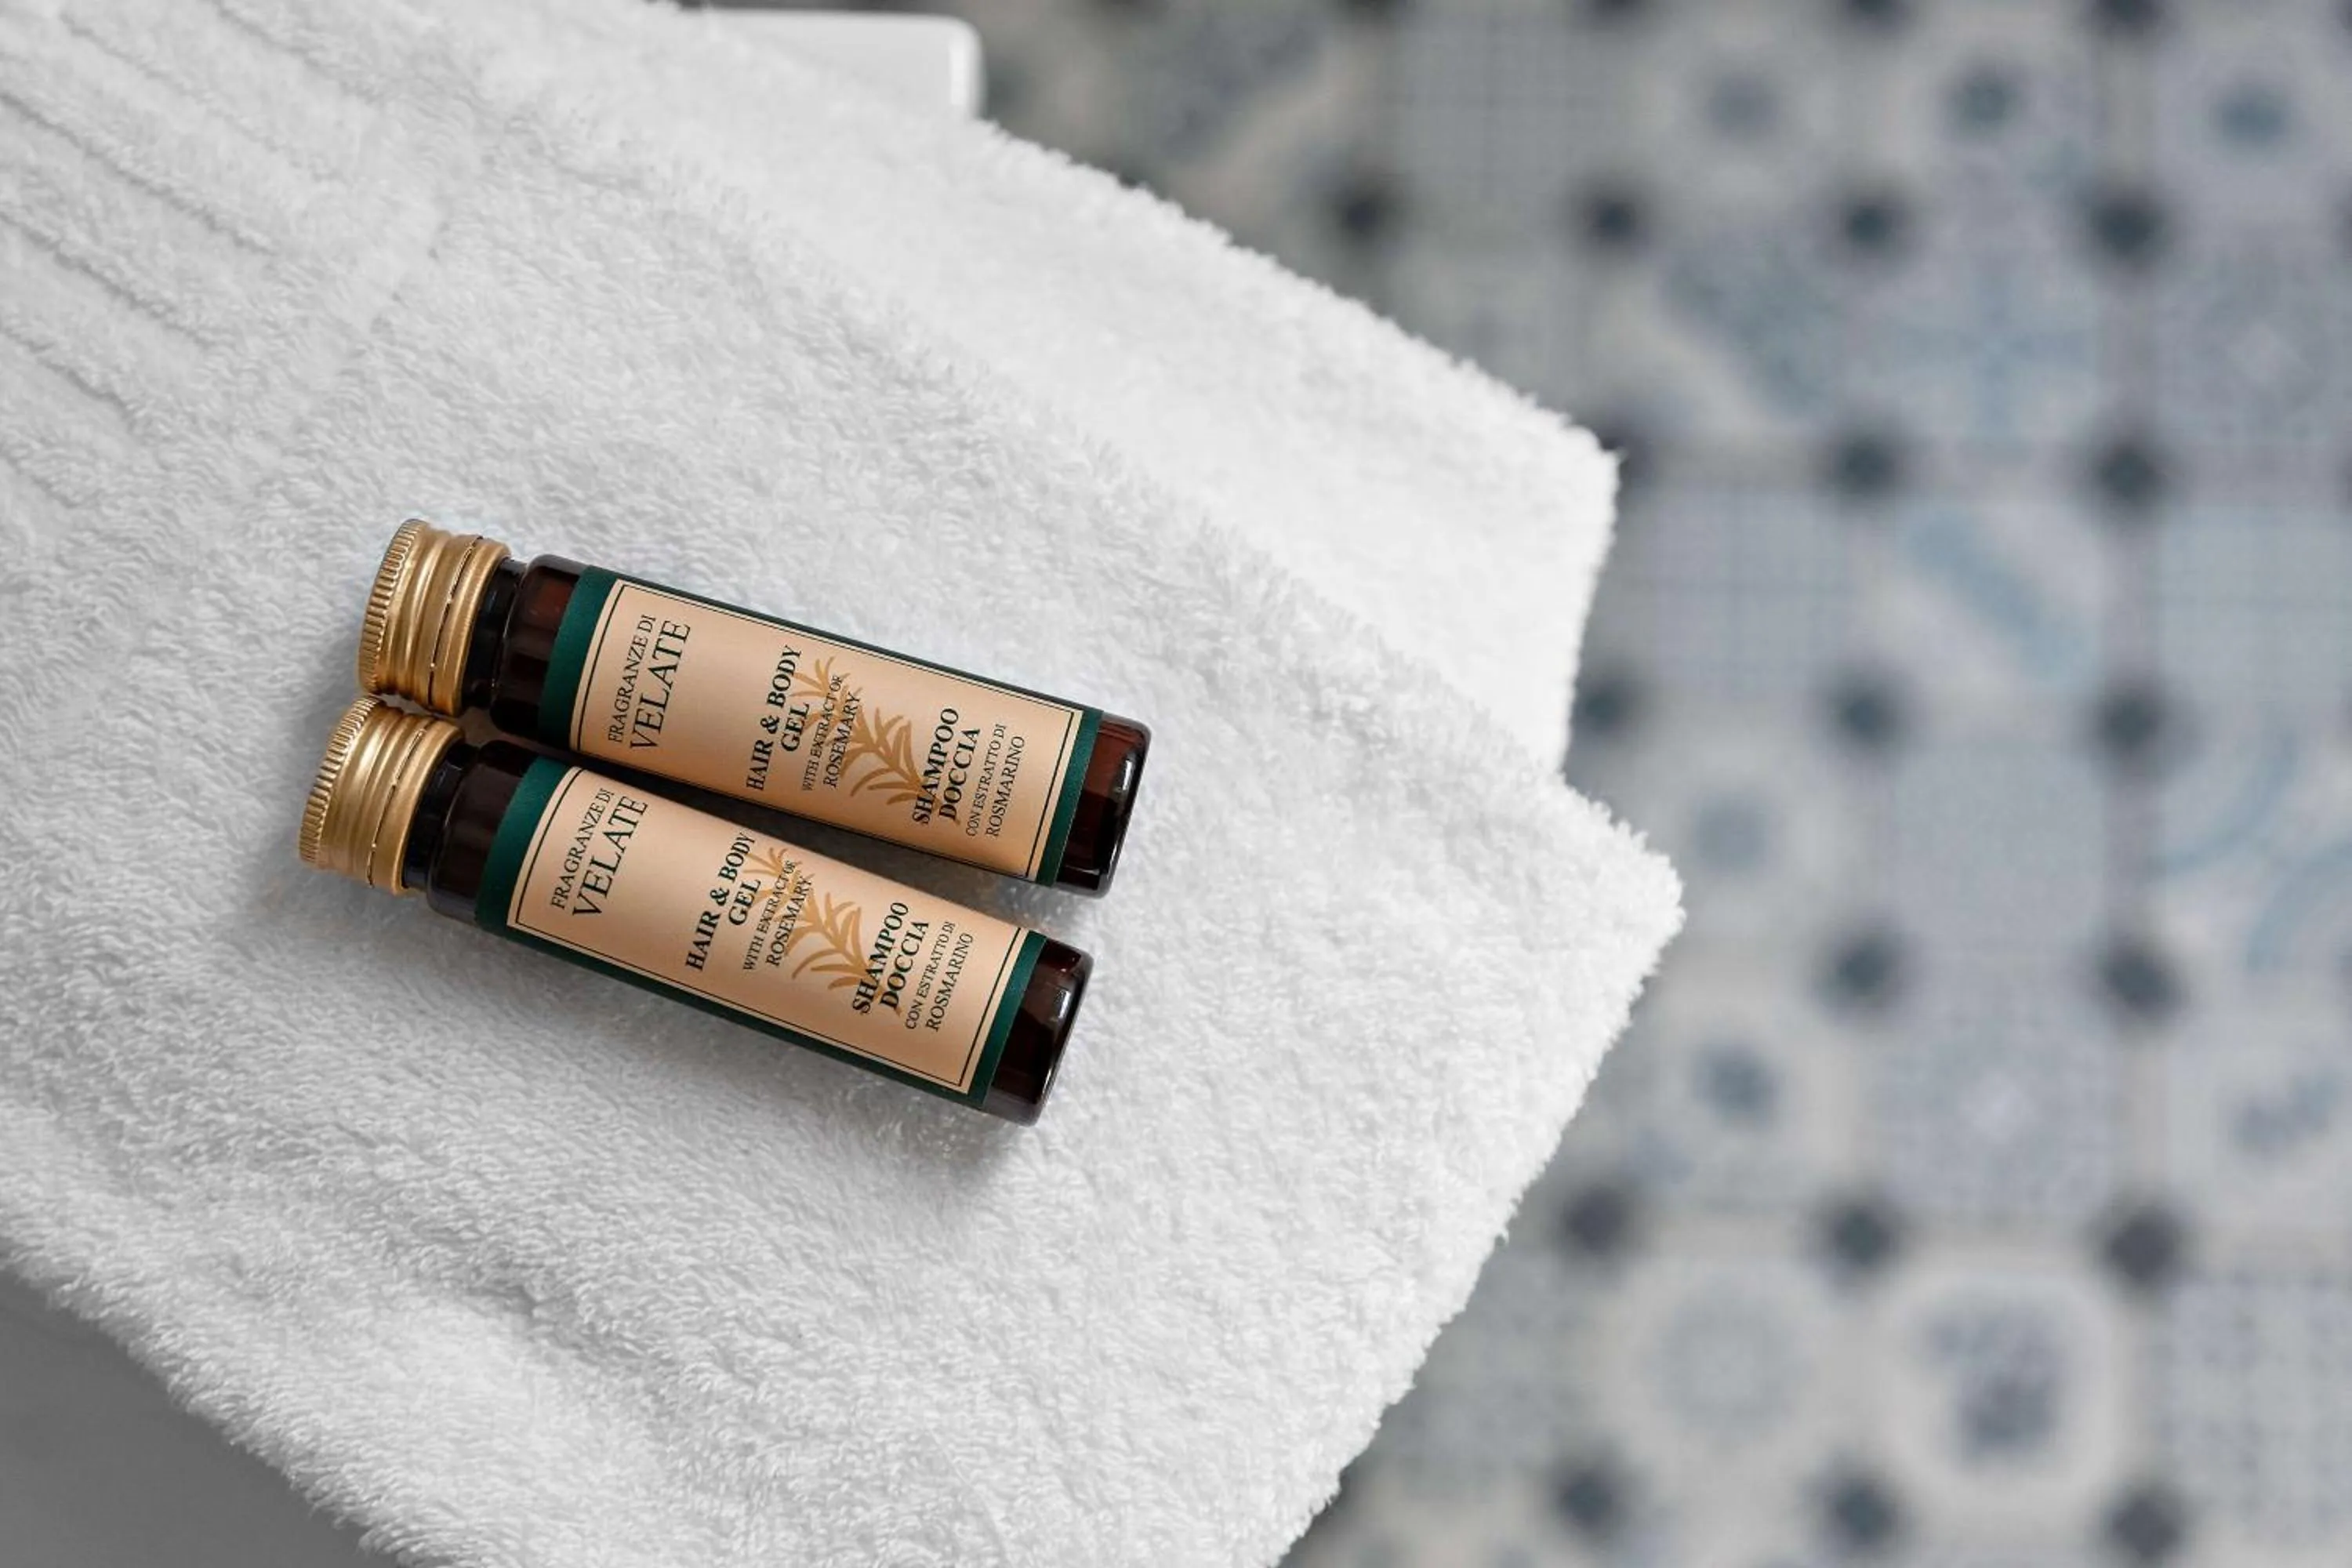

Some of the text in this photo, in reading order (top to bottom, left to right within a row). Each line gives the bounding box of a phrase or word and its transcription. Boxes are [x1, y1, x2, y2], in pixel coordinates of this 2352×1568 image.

[608, 614, 656, 743] FRAGRANZE DI
[630, 620, 691, 749] VELATE
[746, 644, 802, 791] HAIR & BODY
[781, 702, 810, 752] GEL
[801, 675, 843, 792] WITH EXTRACT OF
[822, 691, 861, 788] ROSEMARY
[912, 708, 959, 825] SHAMPOO
[938, 728, 981, 821] DOCCIA
[965, 723, 1007, 837] CON ESTRATTO DI
[985, 735, 1025, 837] ROSMARINO
[550, 787, 615, 910] FRAGRANZE DI
[572, 795, 648, 916] VELATE
[684, 832, 755, 972] HAIR & BODY
[728, 879, 762, 926] GEL
[742, 860, 797, 971] WITH EXTRACT OF
[764, 875, 812, 967] ROSEMARY
[851, 902, 909, 1015] SHAMPOO
[879, 921, 930, 1010] DOCCIA
[905, 920, 956, 1030] CON ESTRATTO DI
[924, 932, 974, 1033] ROSMARINO
